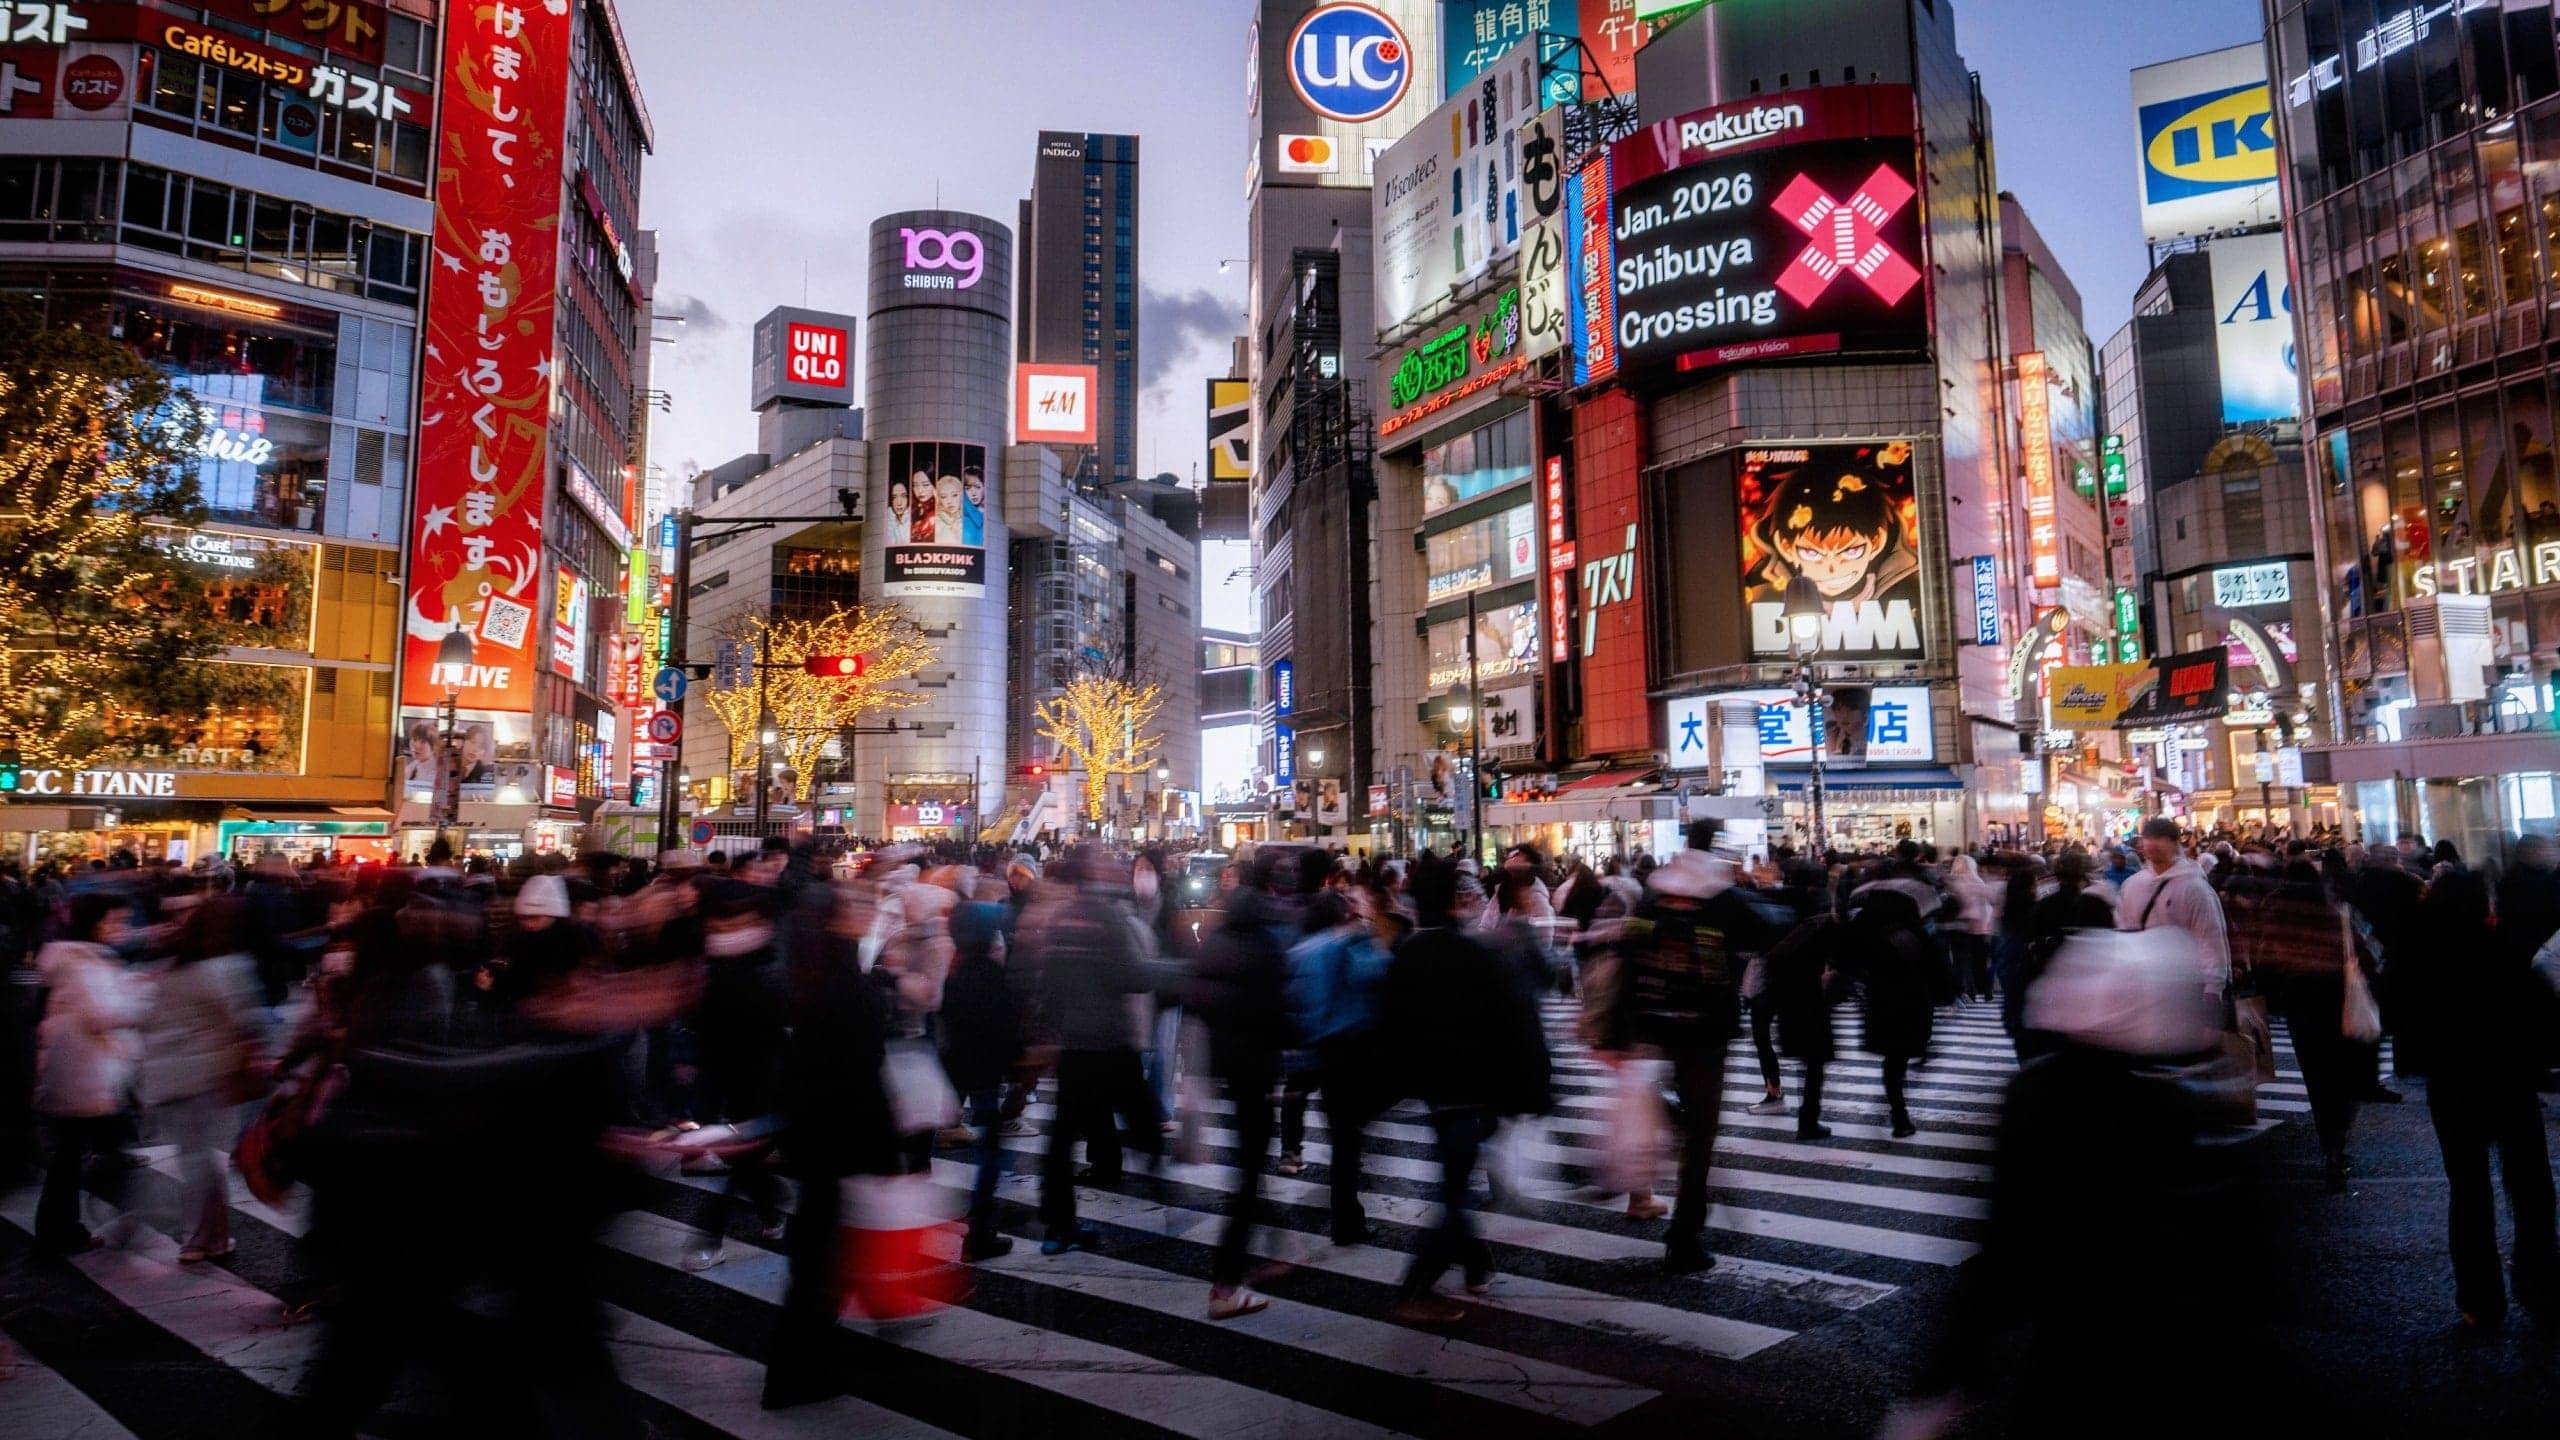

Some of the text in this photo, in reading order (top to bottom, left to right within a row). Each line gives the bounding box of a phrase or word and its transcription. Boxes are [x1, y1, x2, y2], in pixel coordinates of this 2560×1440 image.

[71, 79, 119, 95] ガスト
[309, 64, 412, 121] ガスト
[1681, 103, 1804, 151] Rakuten
[1042, 148, 1080, 158] INDIGO
[1384, 153, 1438, 208] Viscotecs
[1523, 121, 1565, 344] もんじゃ
[900, 228, 984, 289] 109
[1617, 237, 1753, 297] Shibuya
[903, 274, 955, 290] SHIBUYA
[1620, 288, 1777, 349] Crossing
[794, 330, 837, 357] UNI
[1718, 340, 1790, 361] Rakuten Vision
[793, 354, 840, 380] QLO
[1583, 522, 1637, 657] クスリ
[2220, 586, 2286, 605] クリニック
[2234, 567, 2285, 585] れいわ
[1279, 670, 1290, 709] MIZUHO
